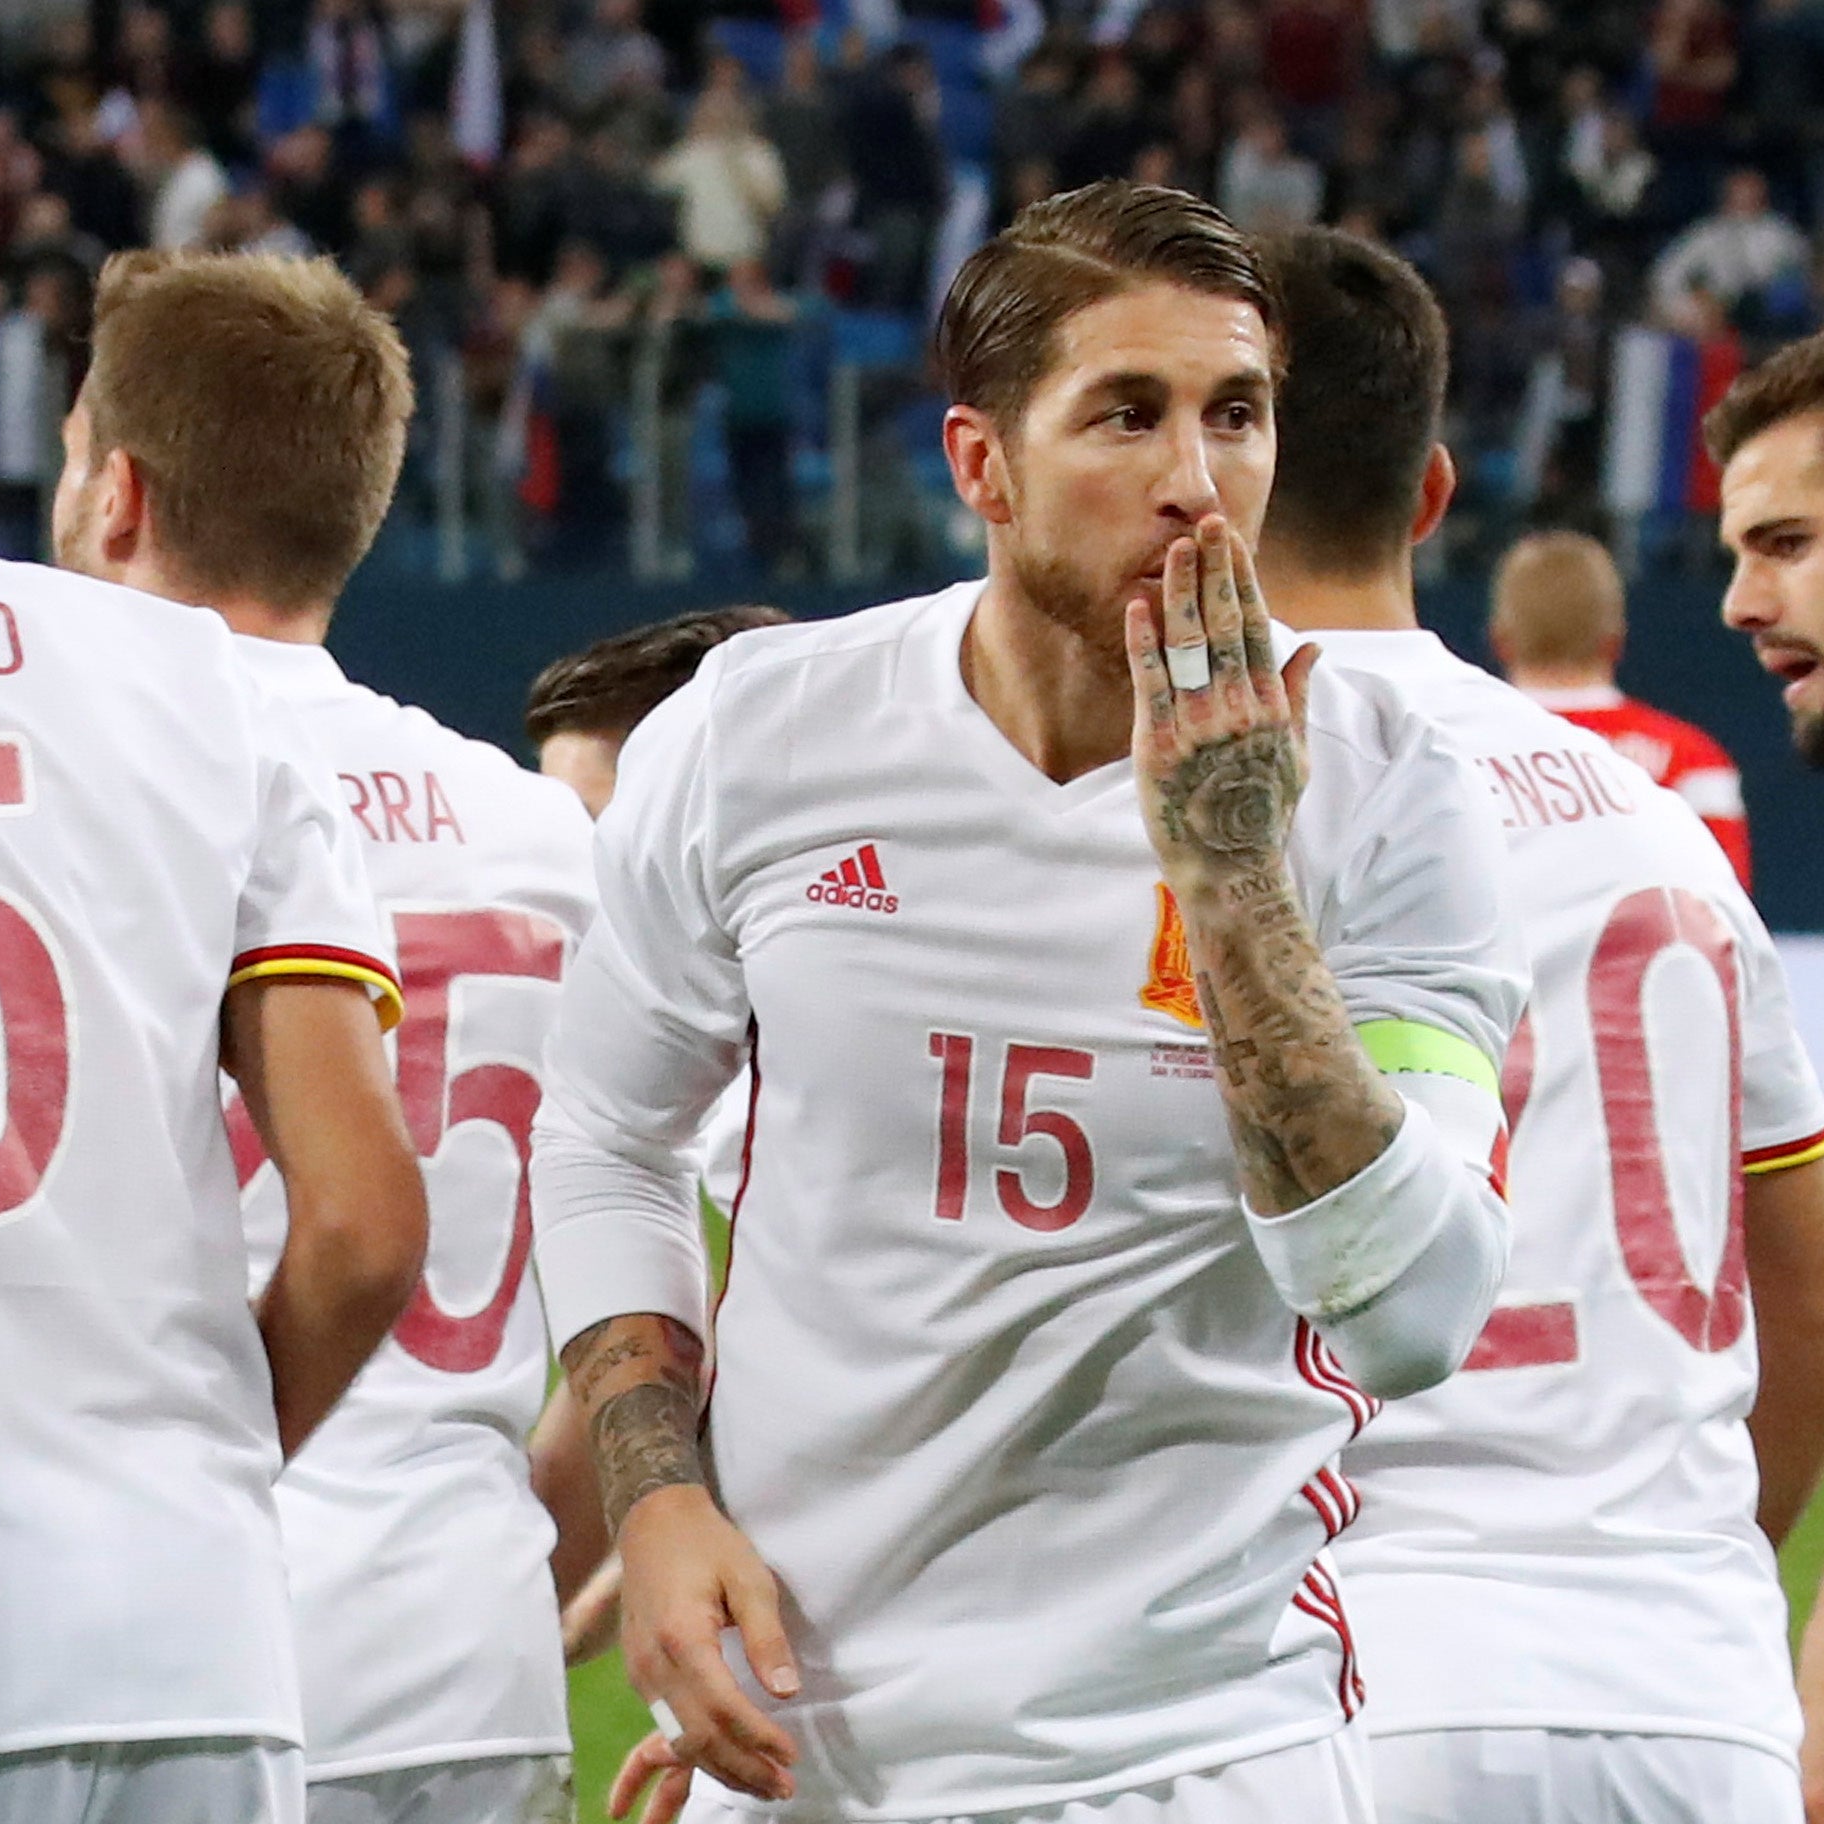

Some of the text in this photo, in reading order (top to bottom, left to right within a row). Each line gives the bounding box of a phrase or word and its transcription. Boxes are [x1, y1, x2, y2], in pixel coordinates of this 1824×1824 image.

[805, 879, 900, 914] adidas
[223, 908, 566, 1374] 5
[929, 1031, 1095, 1233] 15
